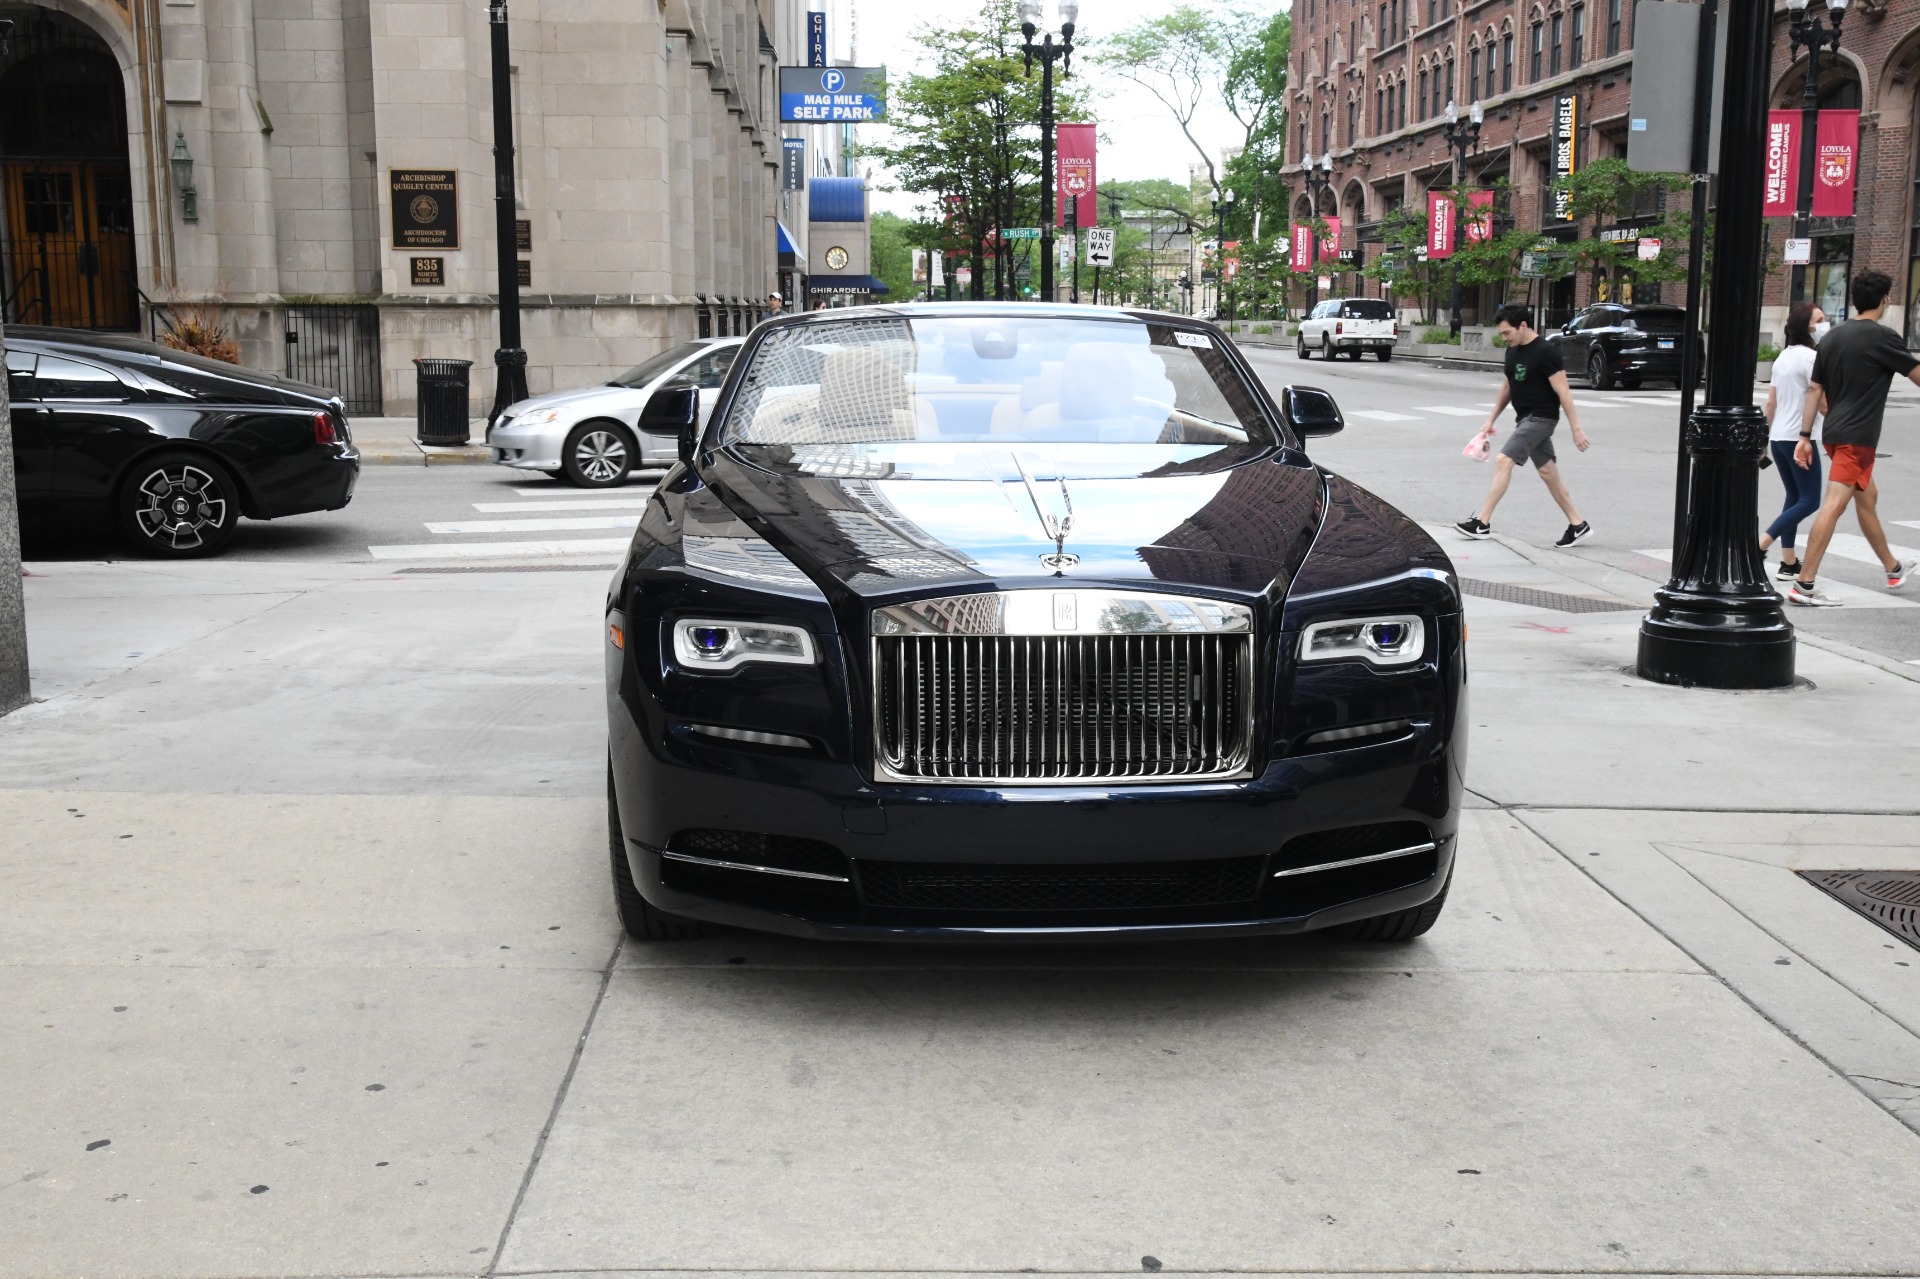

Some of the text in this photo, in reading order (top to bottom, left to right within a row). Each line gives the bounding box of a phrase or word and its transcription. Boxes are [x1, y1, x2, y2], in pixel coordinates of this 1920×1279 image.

[827, 72, 840, 90] P
[804, 95, 863, 105] MAG MILE
[793, 106, 874, 119] SELF PARK
[1559, 97, 1573, 138] BAGELS
[1782, 124, 1790, 152] CAMPUS
[1766, 123, 1783, 203] WELCOME
[1556, 172, 1569, 218] EINSTN
[1434, 199, 1444, 250] WELCOME
[1091, 231, 1112, 241] ONE
[1090, 242, 1111, 250] WAY
[416, 260, 437, 270] 835
